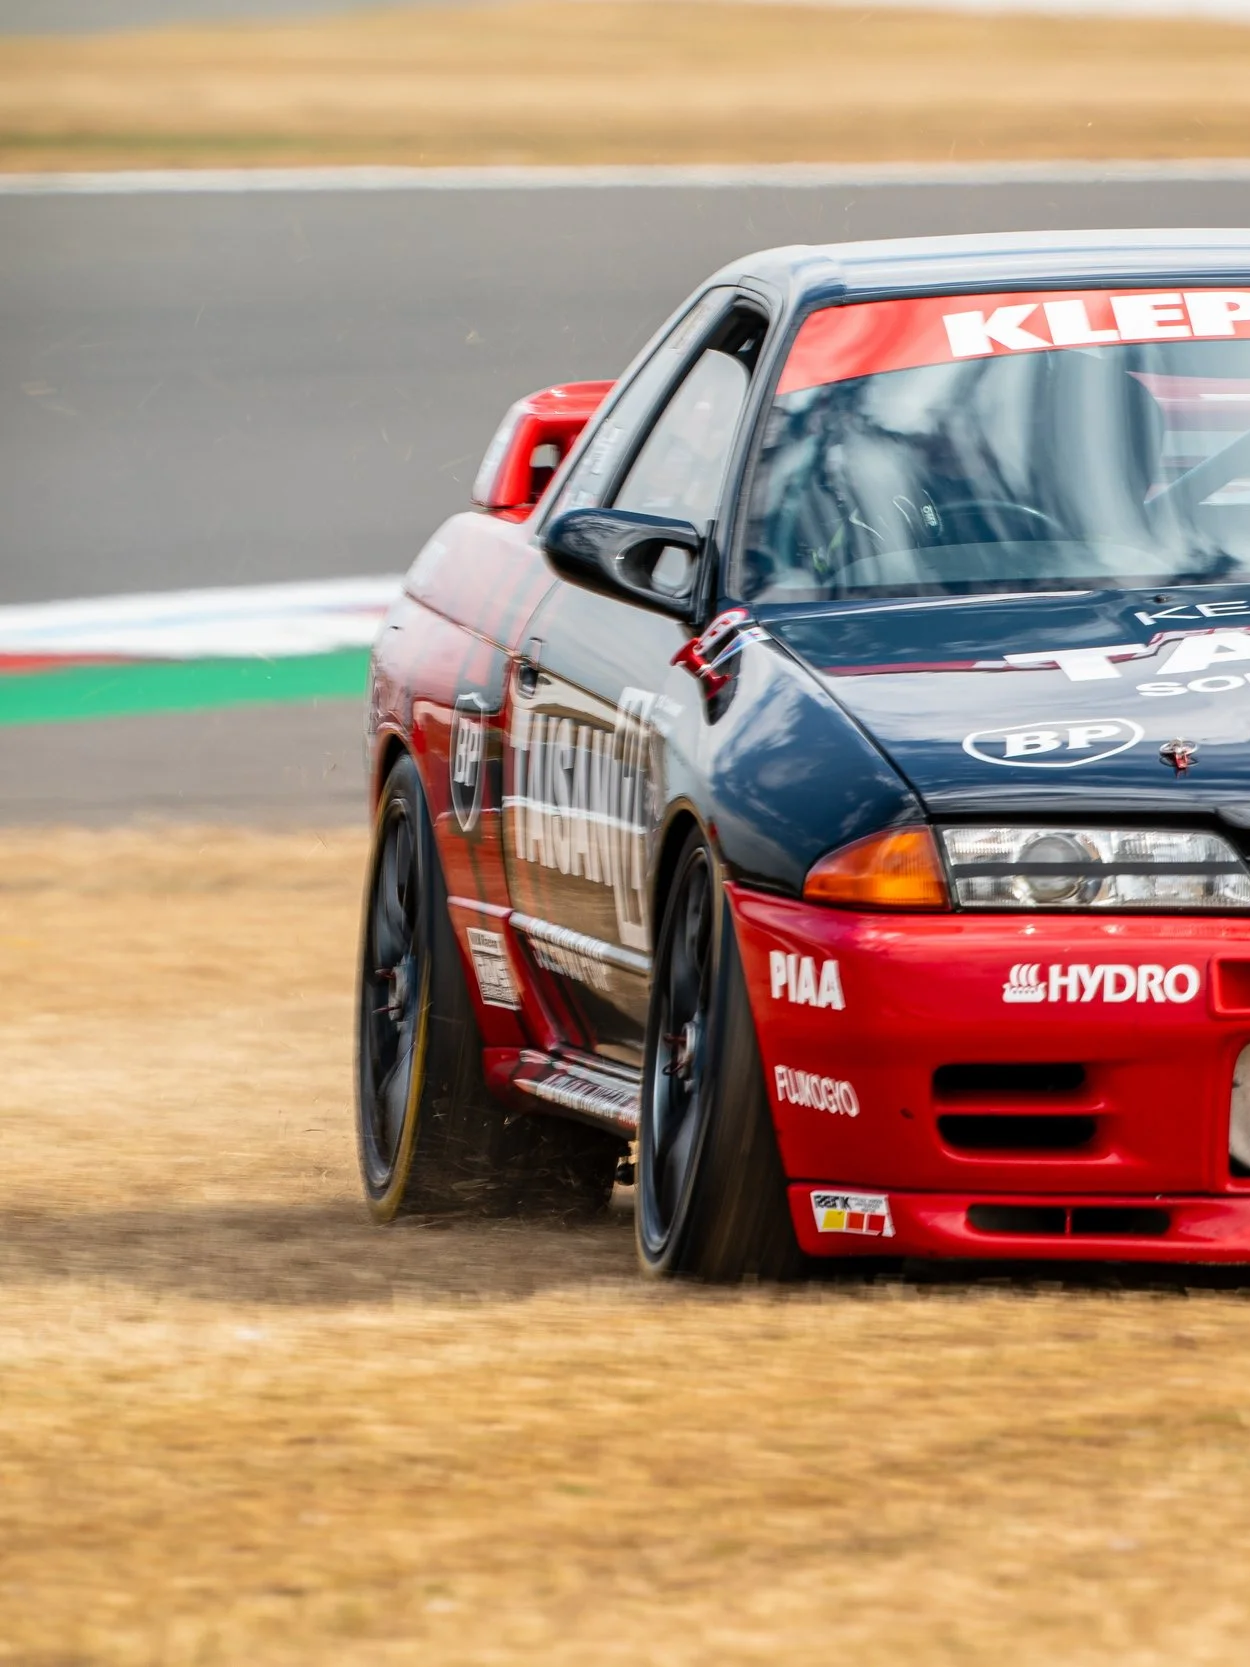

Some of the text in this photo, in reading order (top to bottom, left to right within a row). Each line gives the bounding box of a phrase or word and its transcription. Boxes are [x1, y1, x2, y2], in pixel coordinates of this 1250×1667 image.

[453, 717, 481, 787] BP
[1002, 721, 1122, 759] BP
[510, 706, 618, 888] TAISAN
[769, 949, 846, 1010] PIAA
[1048, 963, 1200, 1003] HYDRO
